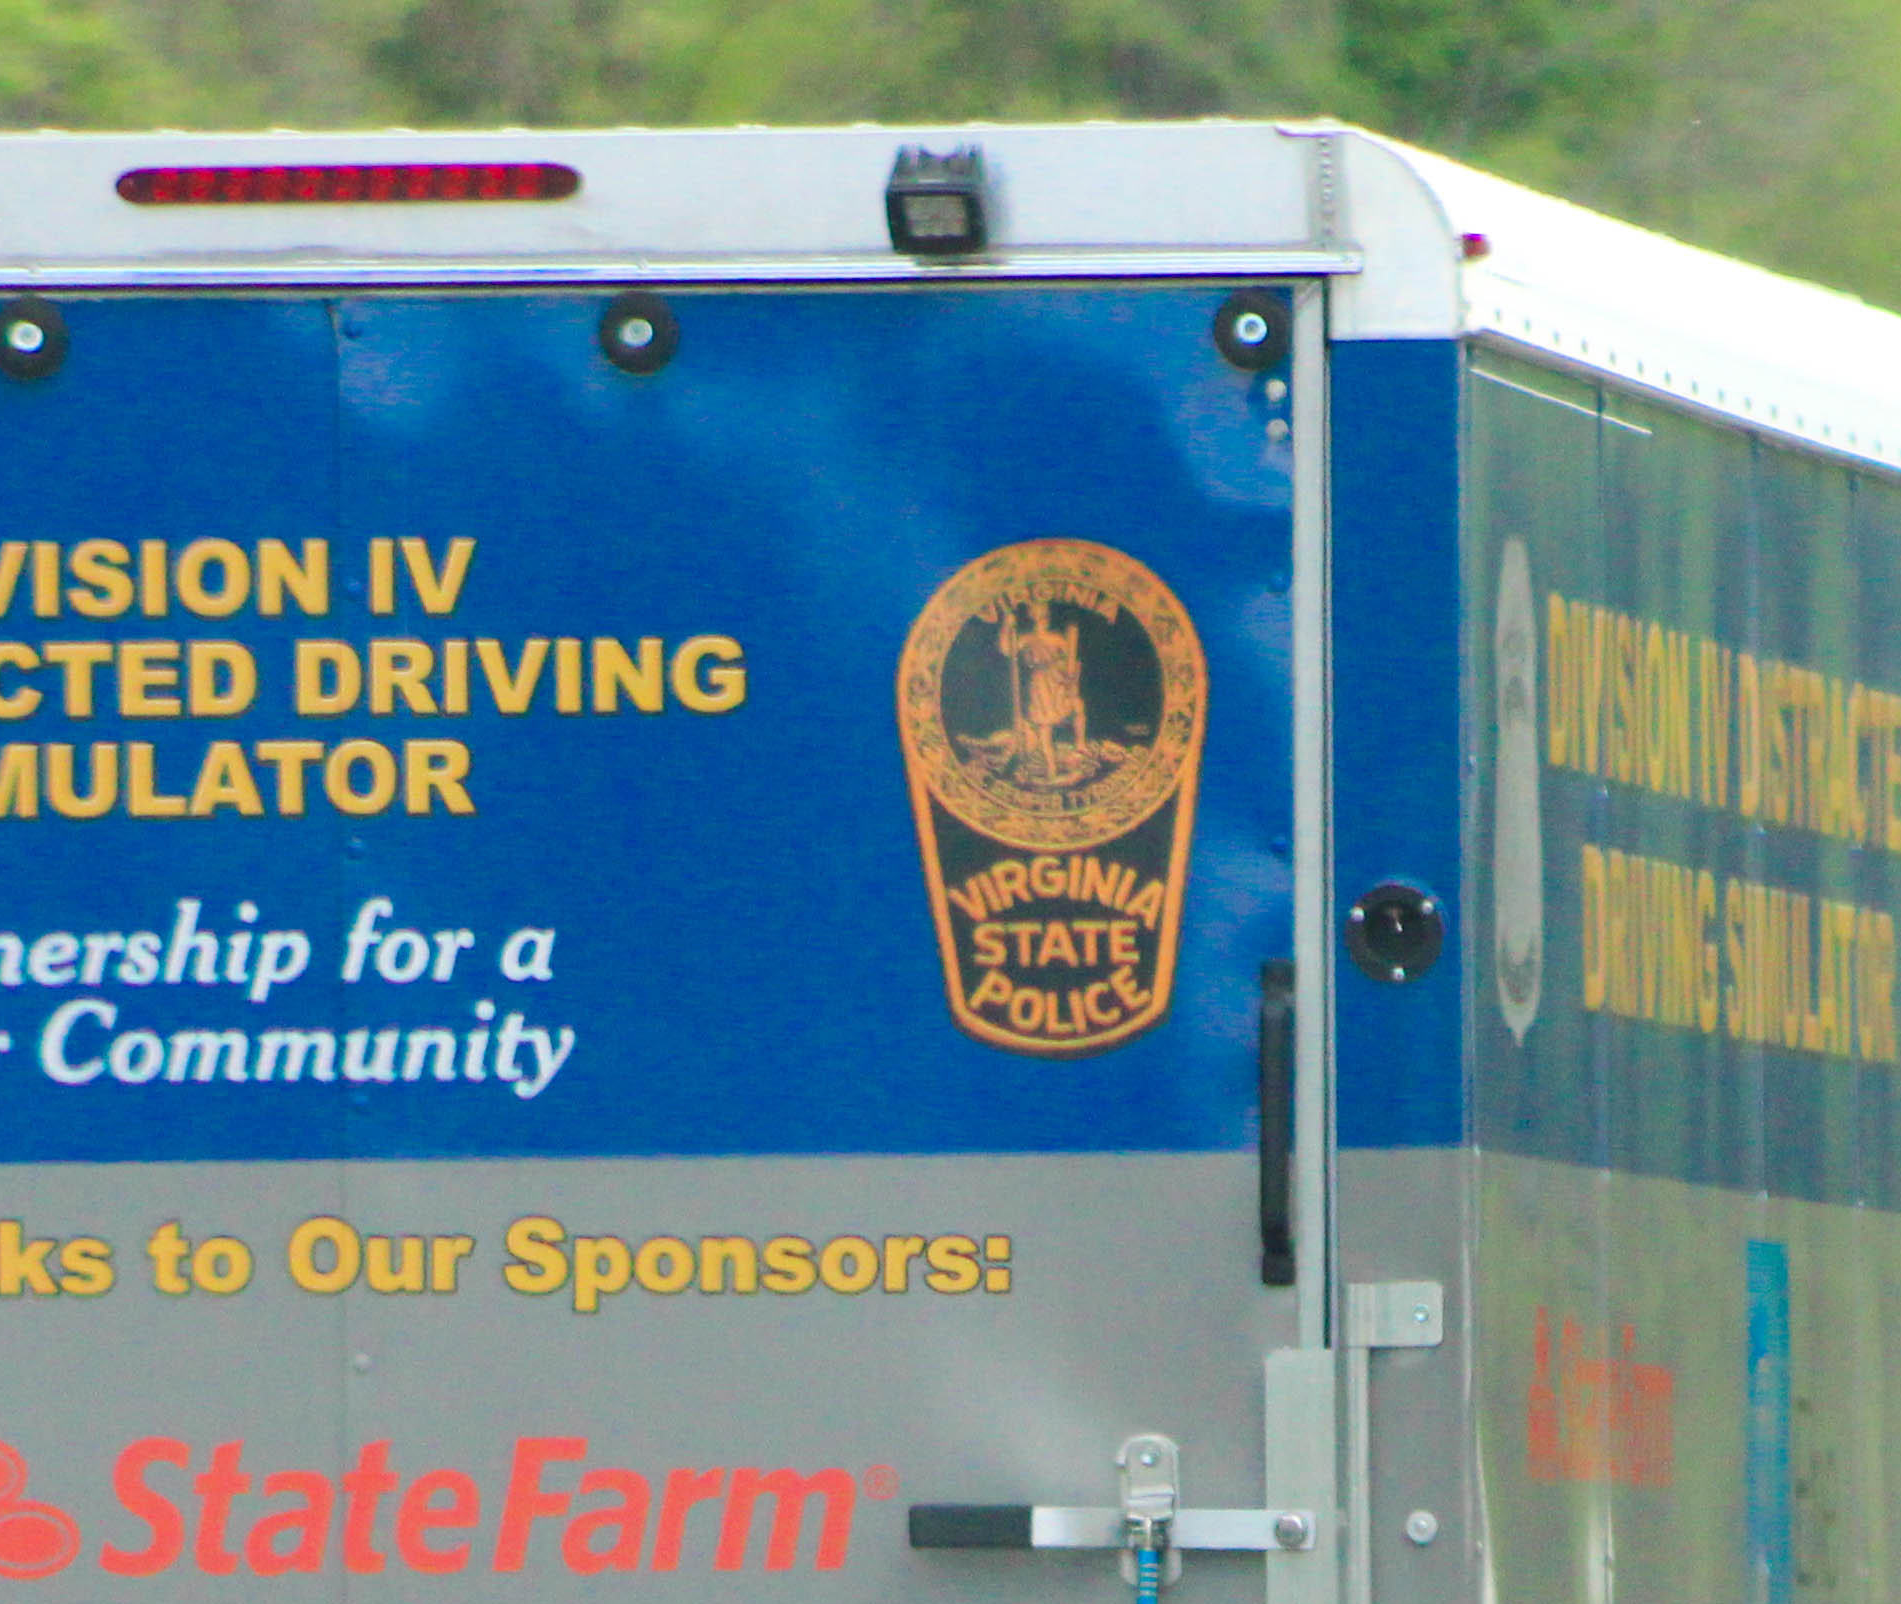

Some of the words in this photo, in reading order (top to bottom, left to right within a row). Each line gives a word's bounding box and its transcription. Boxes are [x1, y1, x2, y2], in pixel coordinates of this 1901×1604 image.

[366, 536, 476, 616] IV
[294, 636, 748, 716] DRIVING
[1546, 590, 1691, 800] DIVISION
[1700, 636, 1732, 808] IV
[945, 856, 1166, 932] VIRGINIA
[340, 896, 476, 986] for
[500, 928, 558, 984] a
[972, 918, 1142, 968] STATE
[1581, 844, 1718, 1034] DRIVING
[1724, 876, 1898, 1064] SIMULATOR
[970, 966, 1152, 1036] POLICE
[38, 998, 578, 1098] Community
[146, 1220, 254, 1296] to
[286, 1218, 476, 1296] Our
[502, 1216, 1014, 1312] Sponsors:
